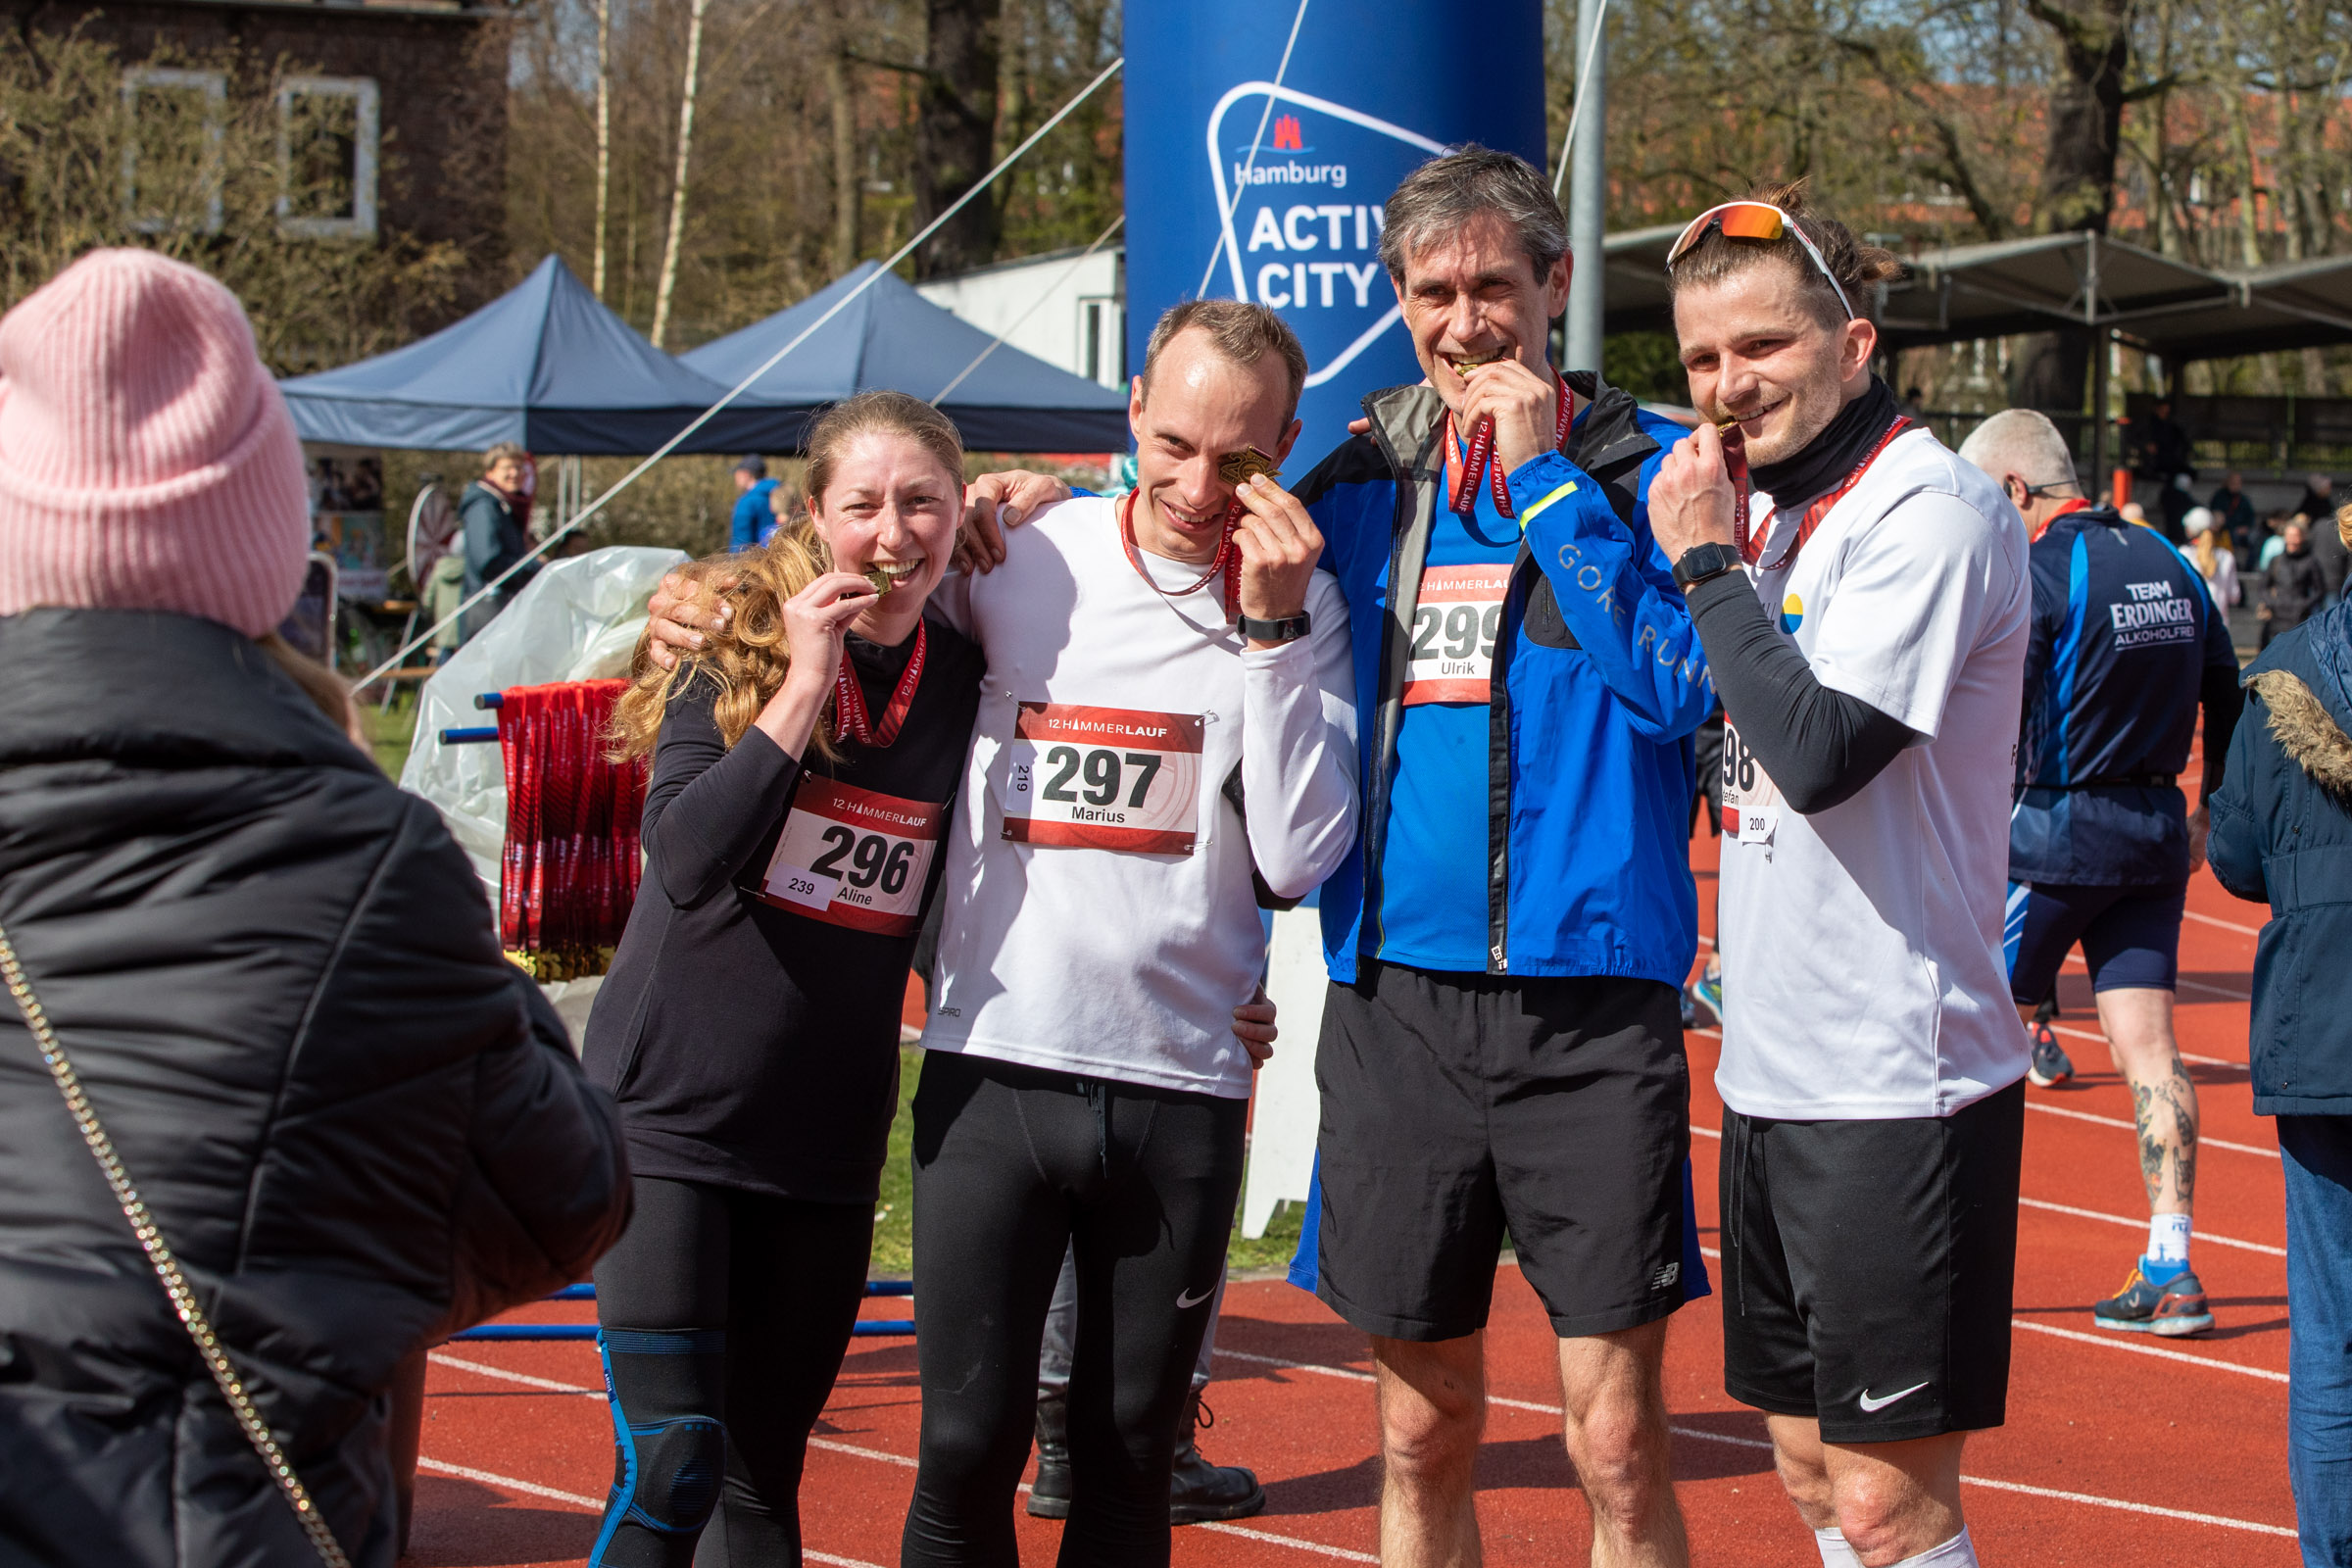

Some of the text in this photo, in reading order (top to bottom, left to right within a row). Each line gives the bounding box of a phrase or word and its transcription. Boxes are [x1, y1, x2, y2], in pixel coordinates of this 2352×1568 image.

[1234, 161, 1347, 188] Hamburg
[1256, 262, 1378, 310] CITY
[1558, 544, 1627, 628] GORE
[2125, 580, 2174, 602] TEAM
[2109, 598, 2195, 629] ERDINGER
[1408, 604, 1503, 662] 299
[1441, 662, 1476, 675] Ulrik
[1015, 764, 1030, 793] 219
[1042, 745, 1162, 808] 297
[1071, 806, 1126, 823] Marius
[1749, 817, 1766, 831] 200
[808, 825, 915, 896] 296
[788, 877, 815, 896] 239
[837, 886, 872, 906] Aline
